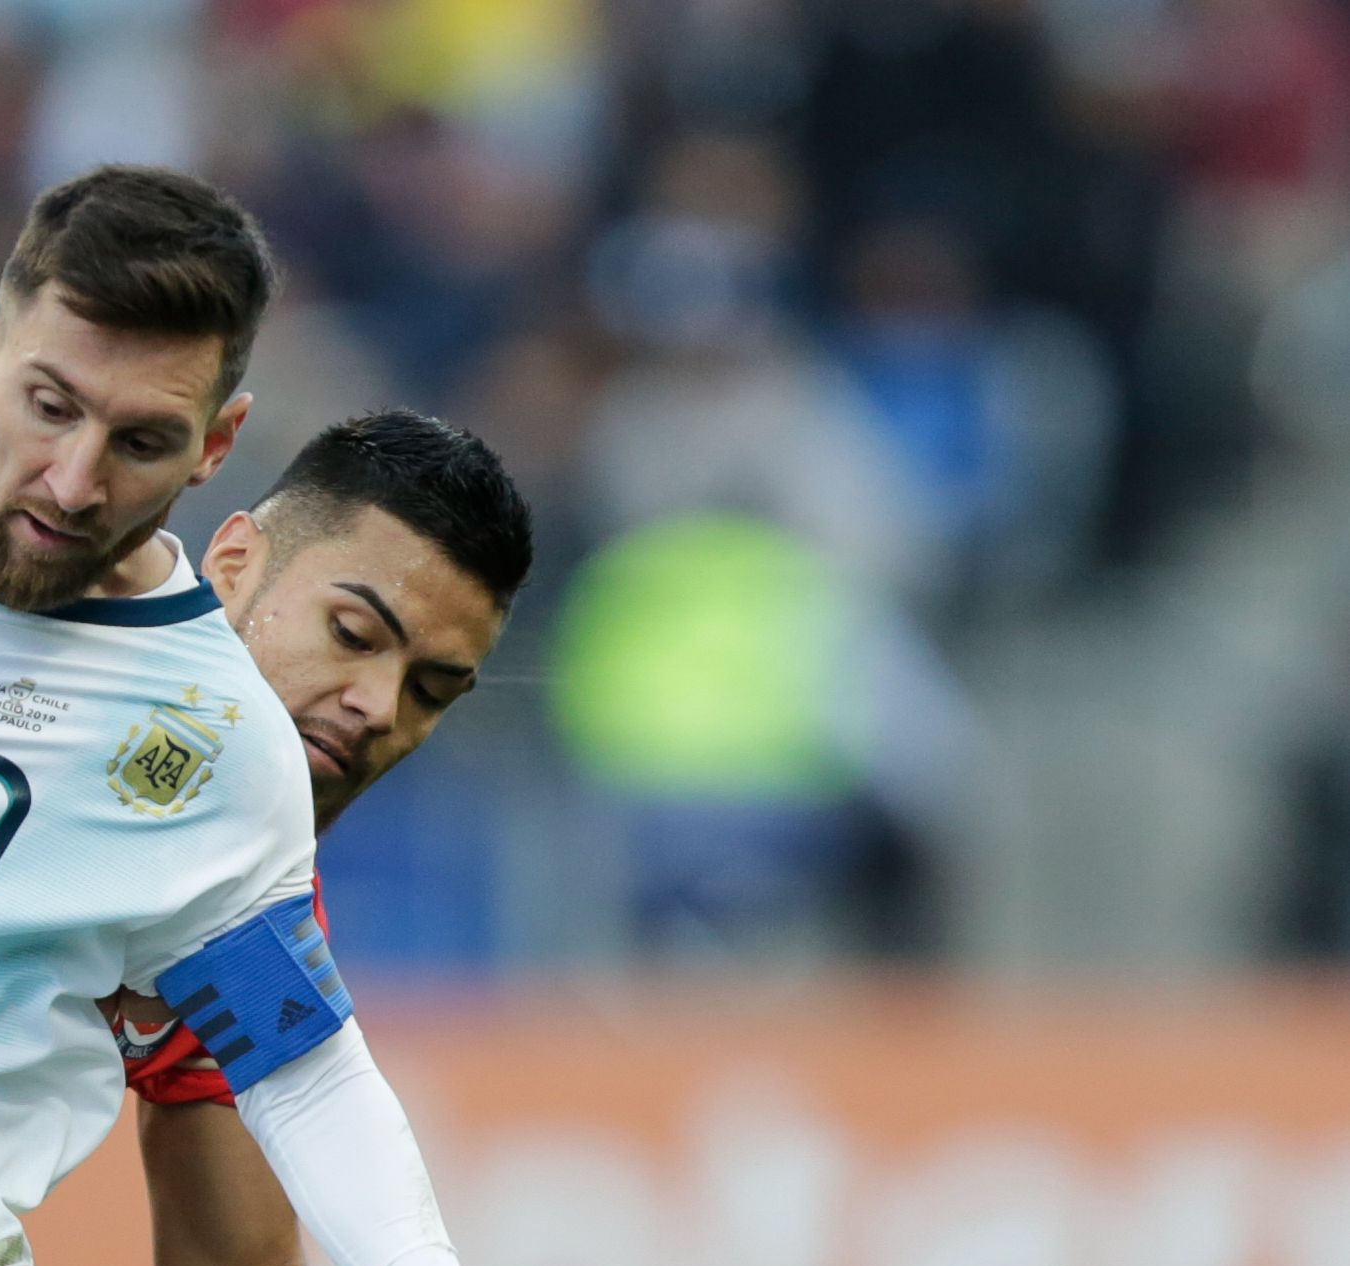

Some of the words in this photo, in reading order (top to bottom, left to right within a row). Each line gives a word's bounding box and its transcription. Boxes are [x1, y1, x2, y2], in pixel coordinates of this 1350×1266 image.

[32, 694, 71, 711] CHILE
[0, 714, 42, 733] PAULO
[26, 708, 57, 723] 2019
[134, 733, 191, 789] AFA
